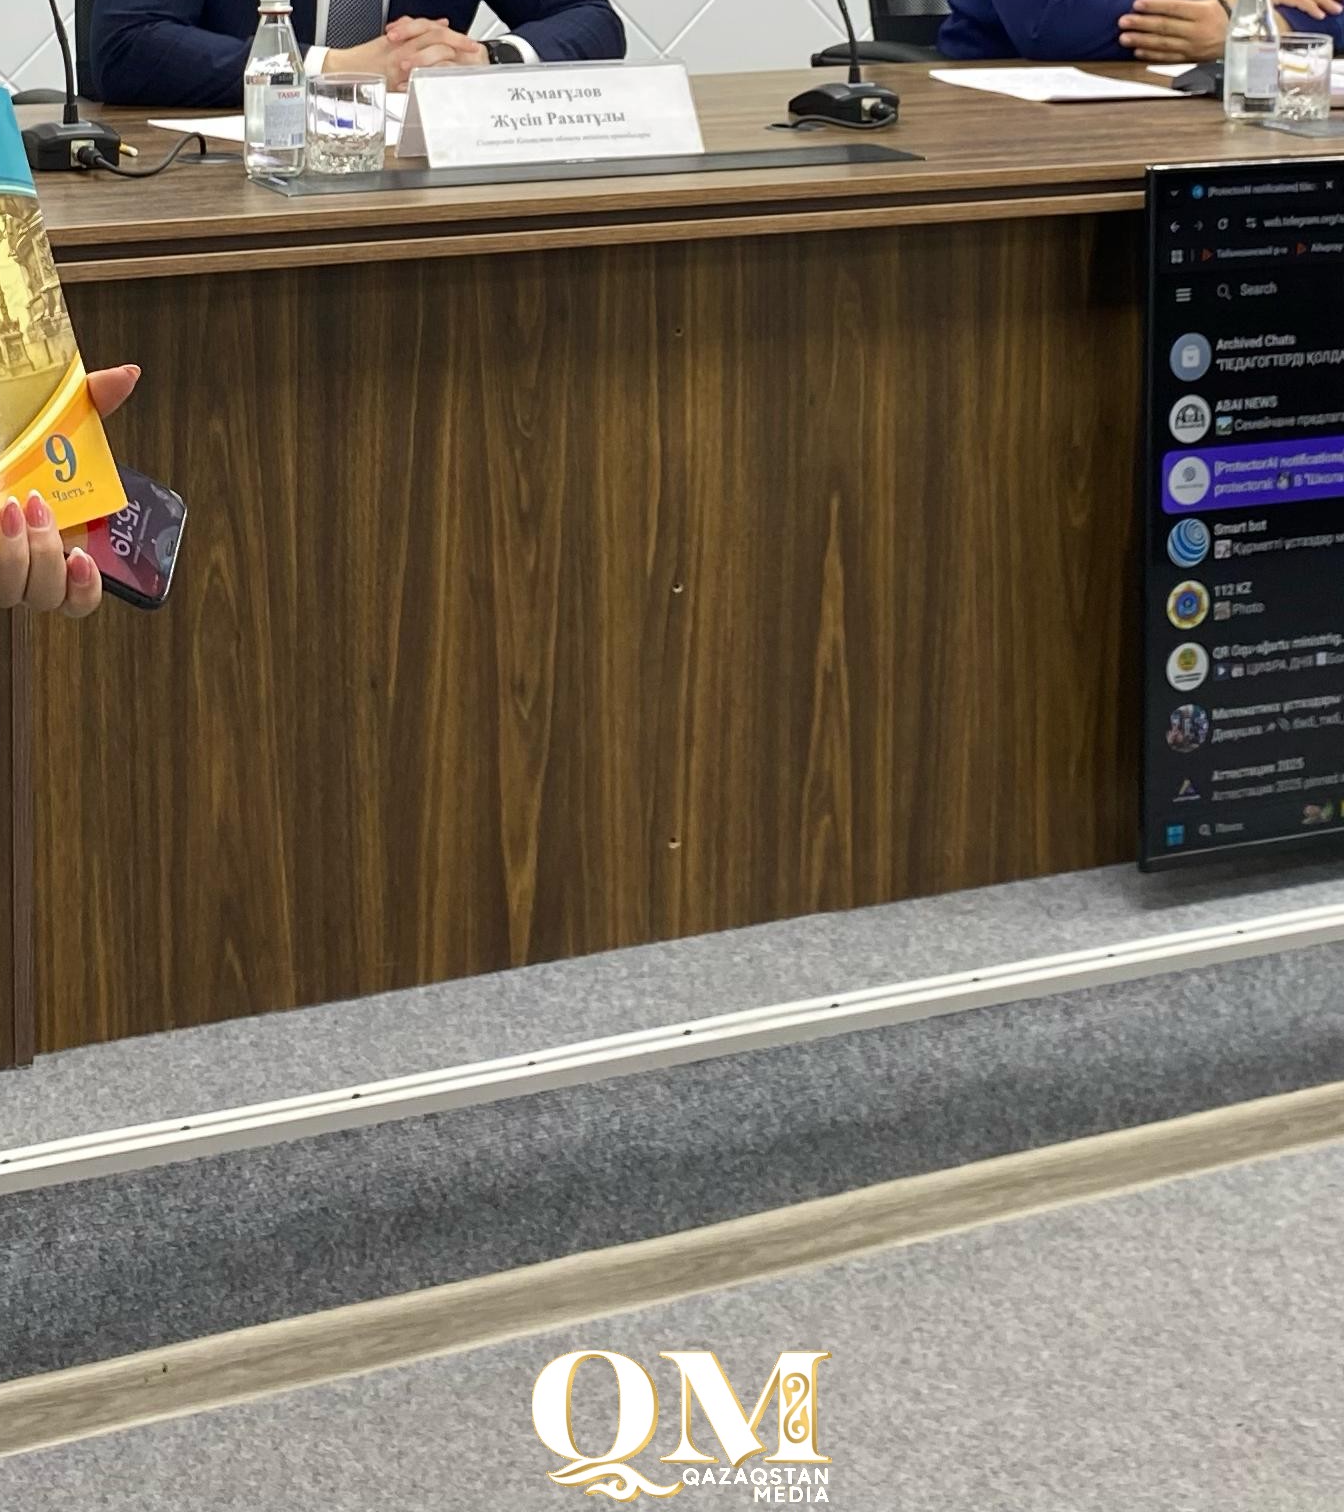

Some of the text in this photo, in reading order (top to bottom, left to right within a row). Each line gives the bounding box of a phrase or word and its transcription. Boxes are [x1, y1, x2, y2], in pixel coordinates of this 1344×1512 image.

[491, 114, 542, 131] Жүсіп
[1240, 282, 1278, 297] Search
[1216, 333, 1297, 351] Archived Chats
[45, 434, 77, 483] 9
[52, 480, 94, 501] Часть 2
[110, 500, 141, 557] 15:19
